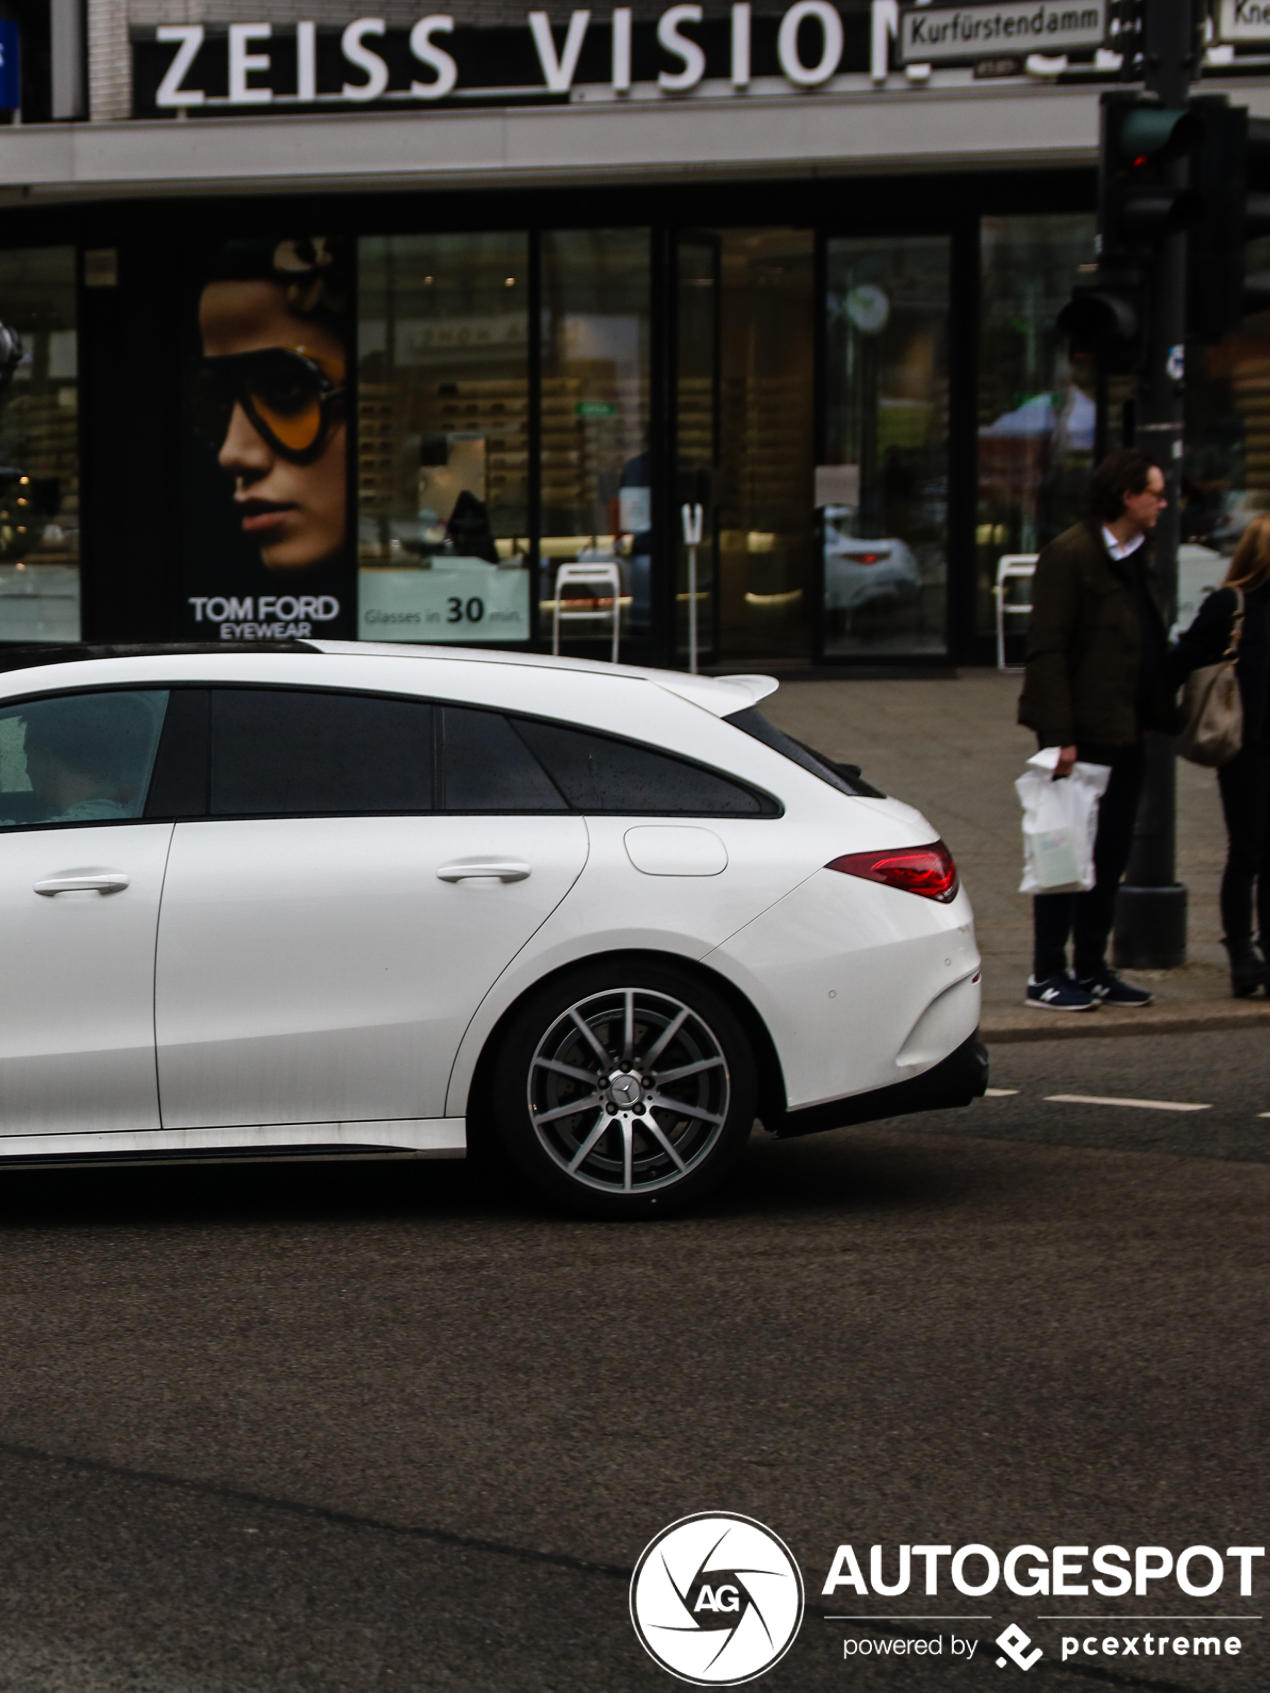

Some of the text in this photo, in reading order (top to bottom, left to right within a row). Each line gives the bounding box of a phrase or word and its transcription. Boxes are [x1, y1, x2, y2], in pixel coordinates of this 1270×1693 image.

[911, 5, 1099, 45] Kurfürstendamm
[155, 14, 458, 108] ZEISS
[187, 595, 340, 622] TOM FORD
[364, 608, 421, 625] Glasses
[424, 607, 442, 623] in
[446, 596, 485, 624] 30
[220, 622, 312, 639] EYEWEAR
